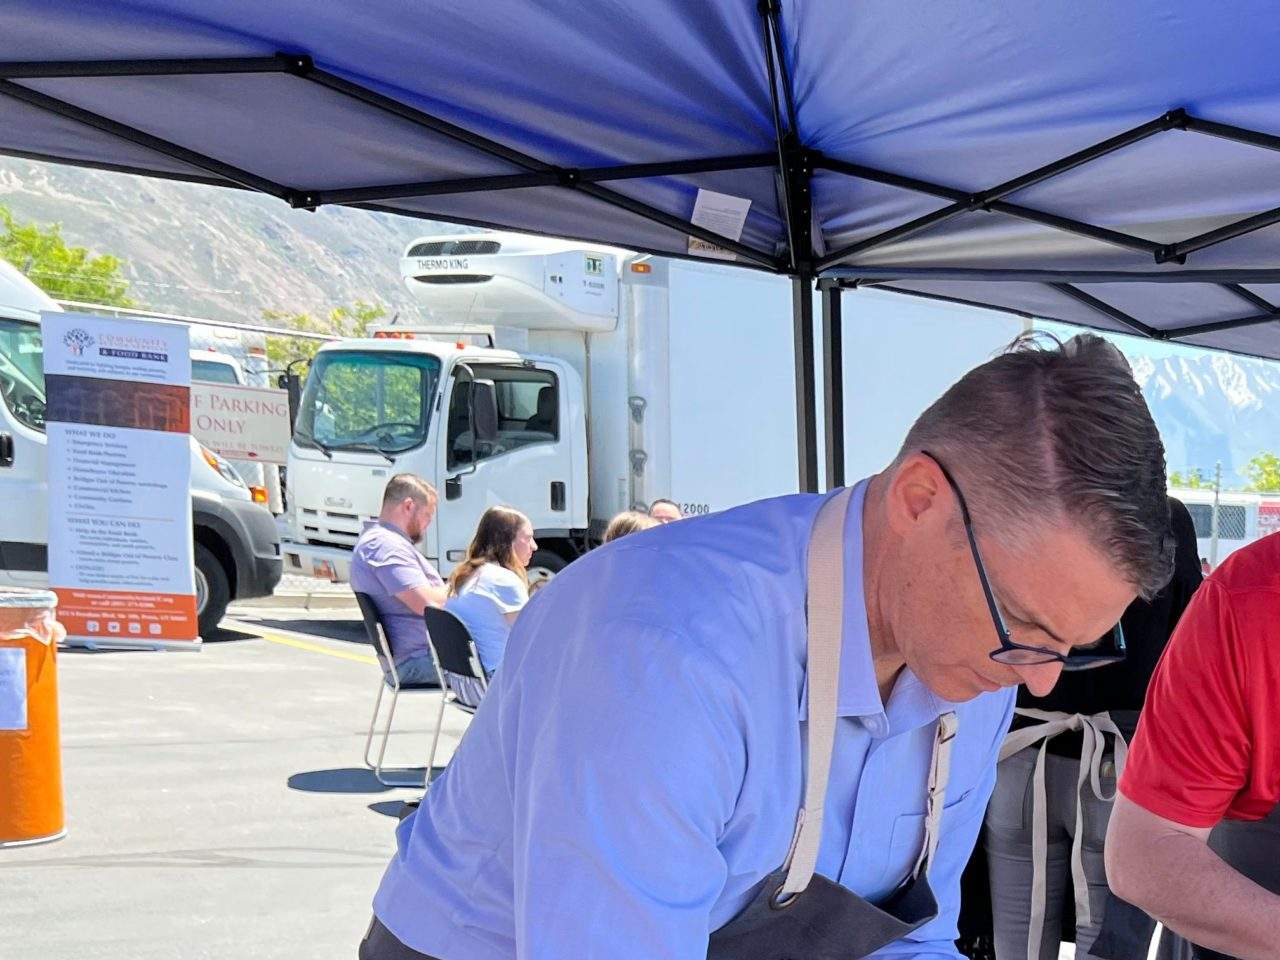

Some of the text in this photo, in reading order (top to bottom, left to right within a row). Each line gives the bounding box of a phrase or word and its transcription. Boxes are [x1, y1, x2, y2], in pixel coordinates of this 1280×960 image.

[417, 258, 469, 270] THERMO KING
[210, 394, 287, 417] PARKING
[197, 415, 246, 434] ONLY
